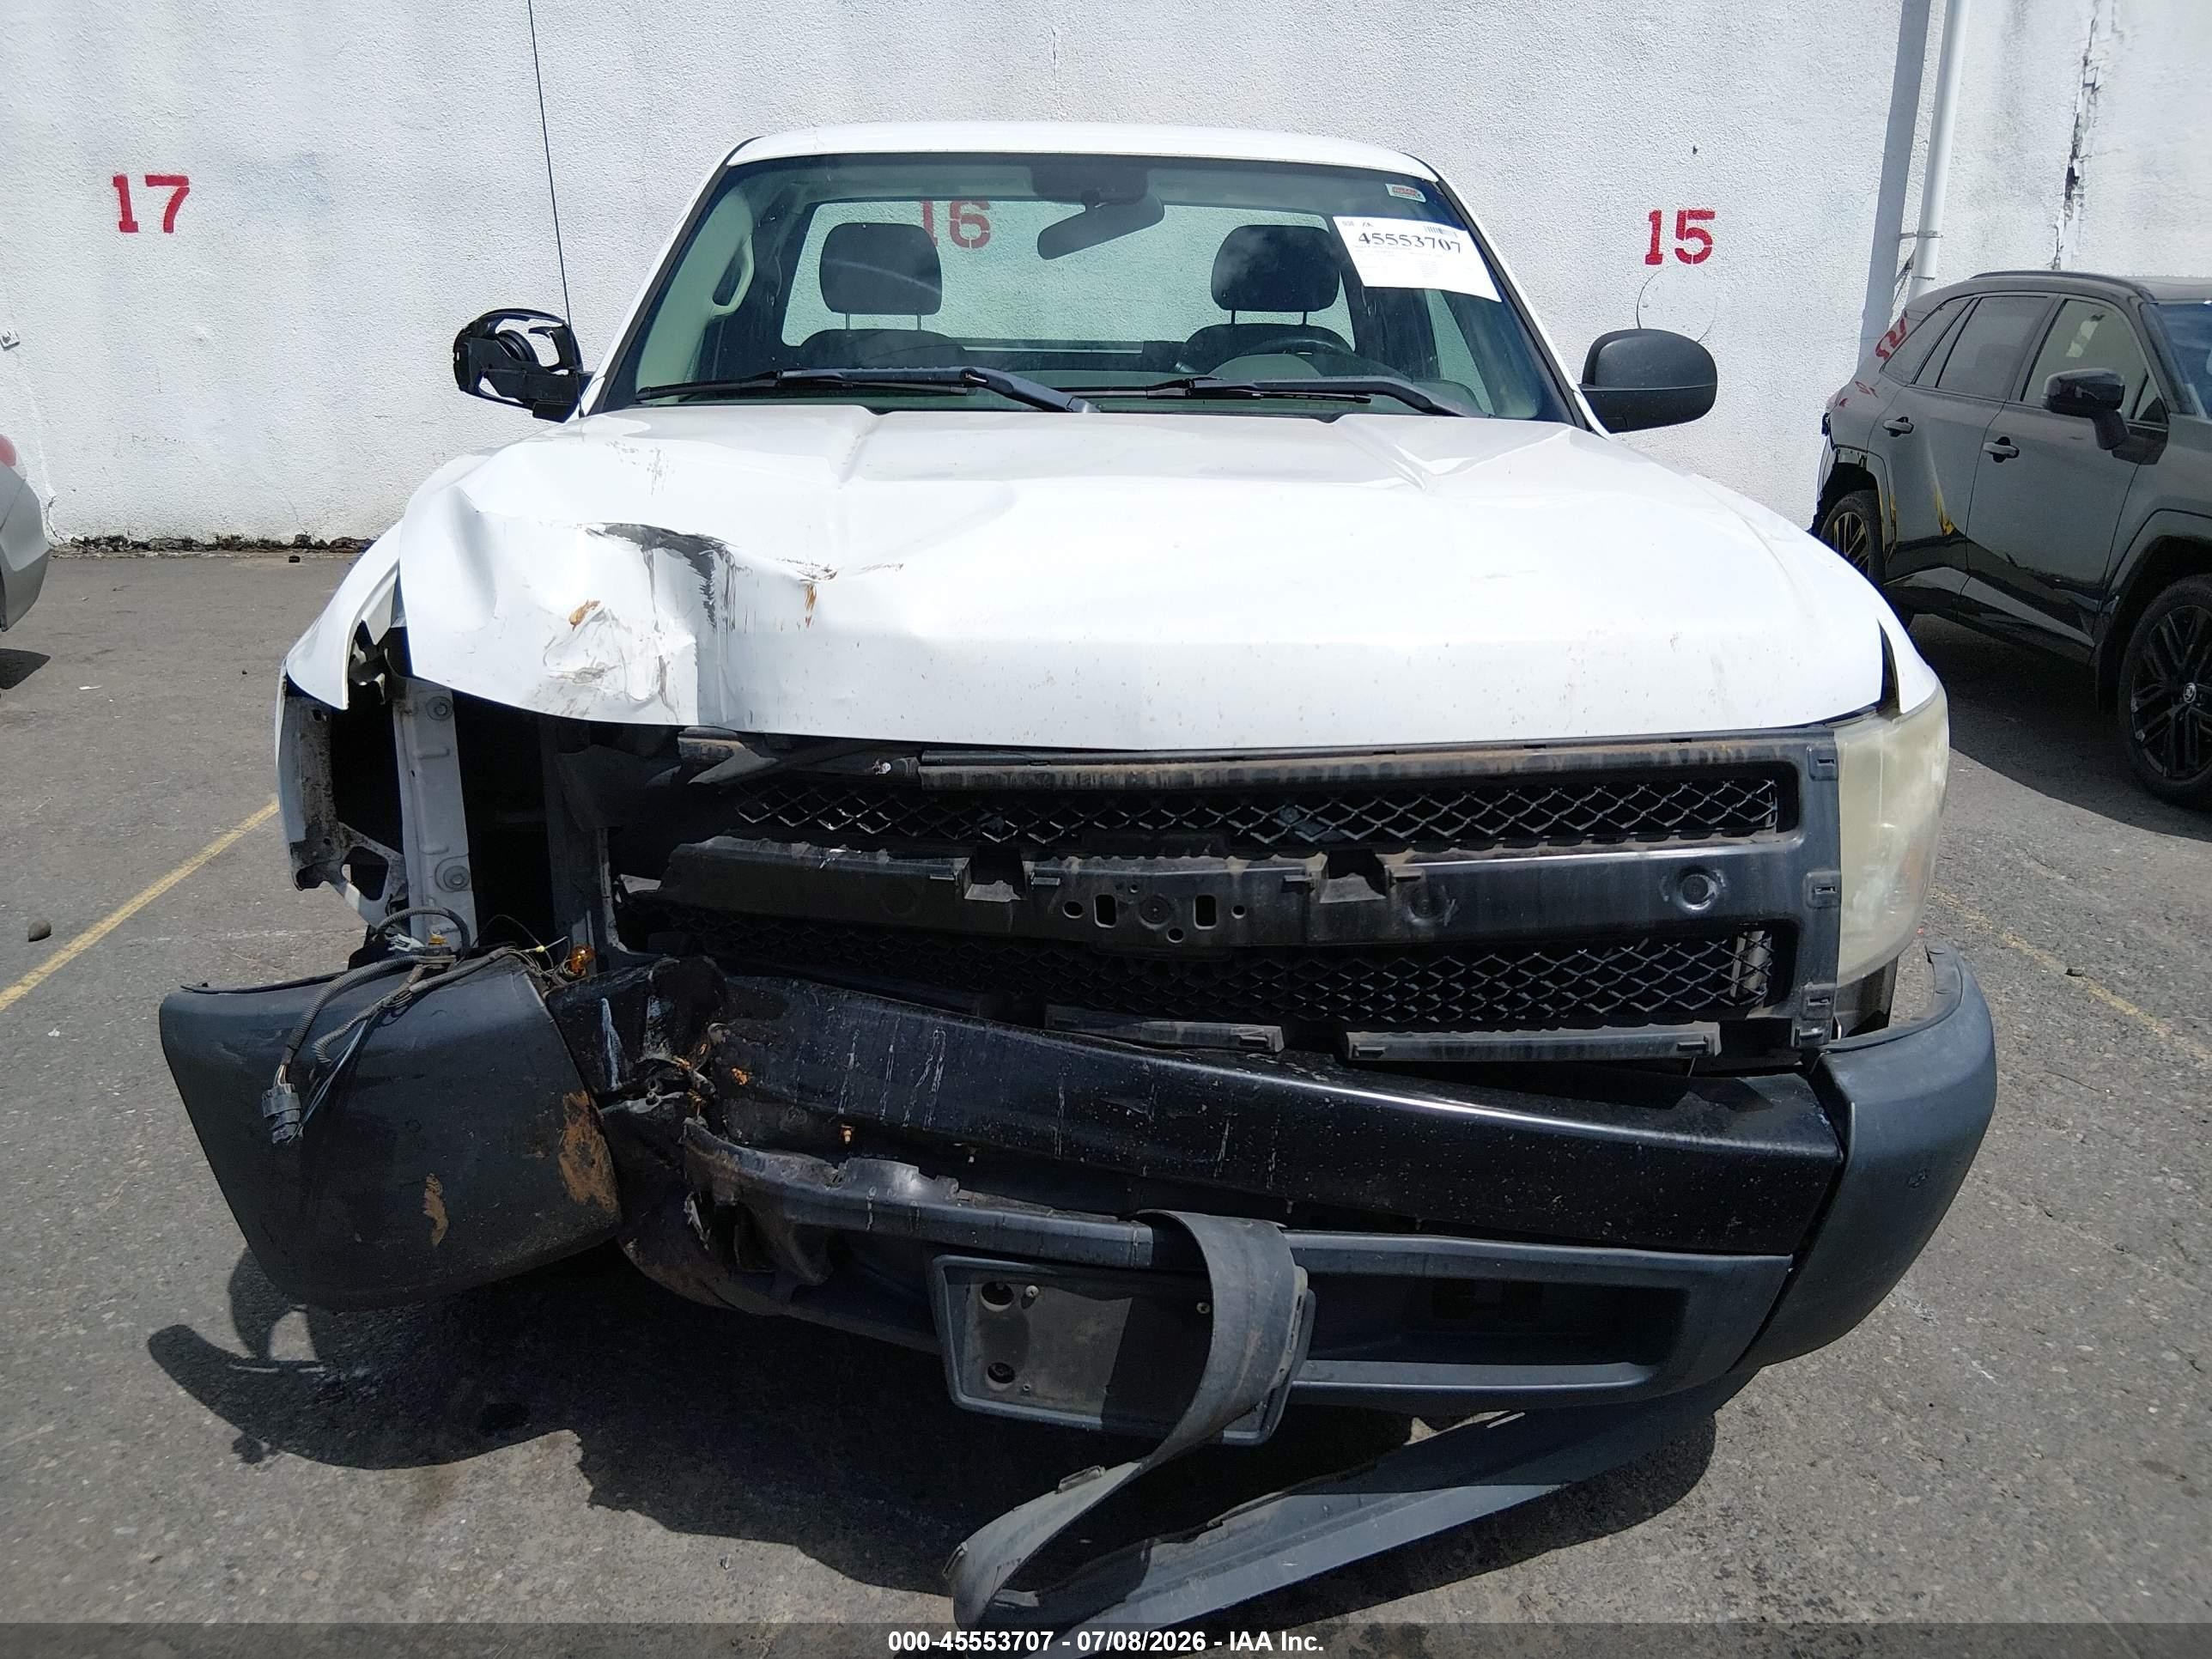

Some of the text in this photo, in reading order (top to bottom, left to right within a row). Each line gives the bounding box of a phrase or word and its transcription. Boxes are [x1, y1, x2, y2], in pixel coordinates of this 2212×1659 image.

[112, 174, 191, 234] 17
[921, 200, 991, 249] 16
[1358, 232, 1462, 254] 45553707
[1644, 210, 1716, 266] 15
